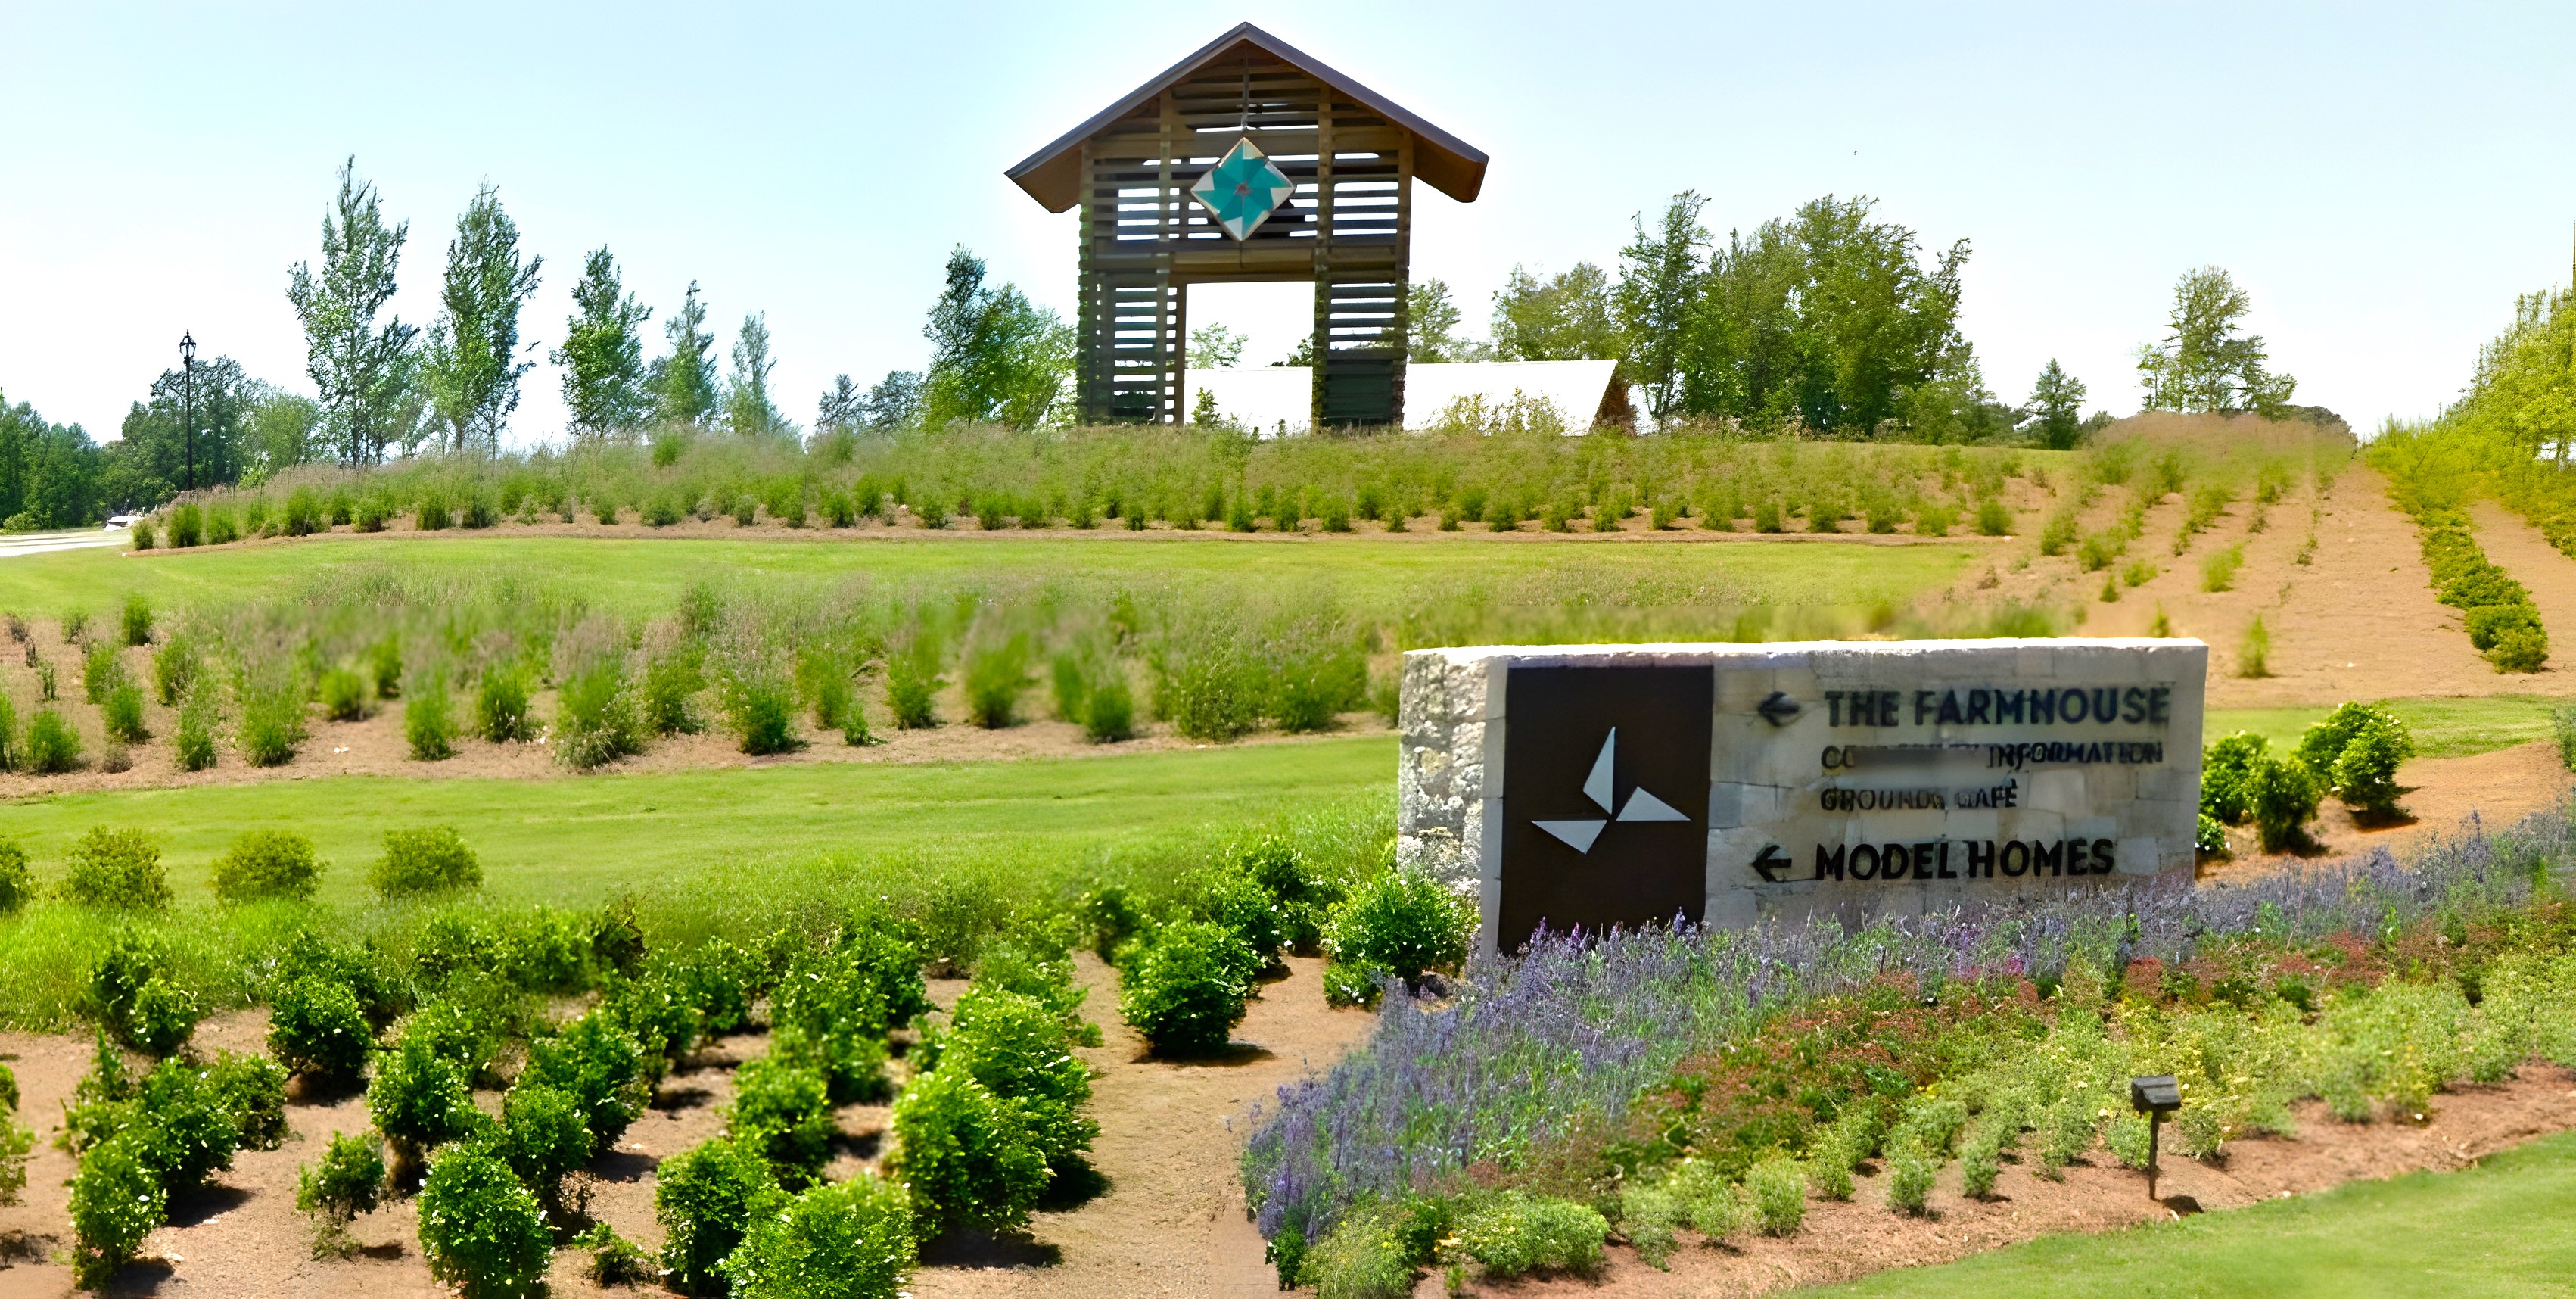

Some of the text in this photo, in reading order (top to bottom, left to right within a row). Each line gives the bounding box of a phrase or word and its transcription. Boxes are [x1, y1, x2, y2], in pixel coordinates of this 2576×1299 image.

[1825, 690, 1900, 727] THE
[1817, 838, 2114, 880] MODEL HOMES
